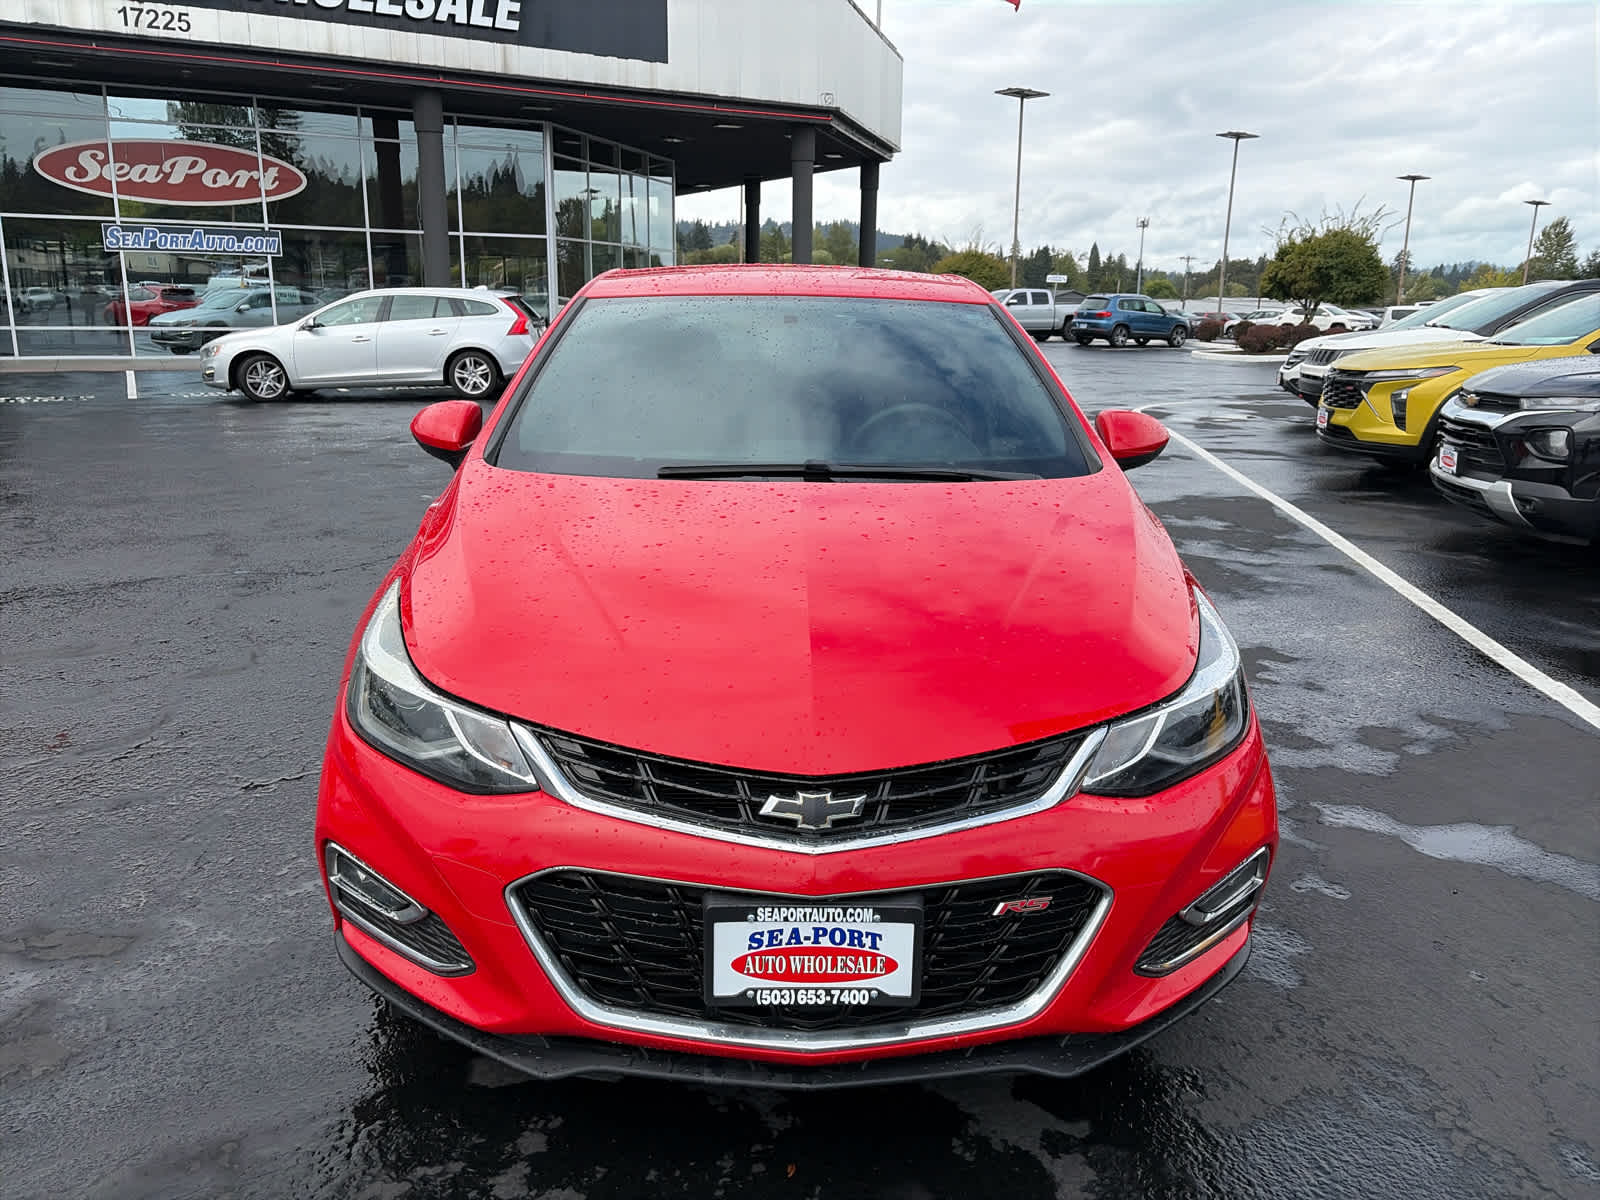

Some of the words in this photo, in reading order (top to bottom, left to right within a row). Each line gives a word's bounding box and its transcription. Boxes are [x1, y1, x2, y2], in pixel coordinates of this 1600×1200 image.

[117, 6, 191, 32] 17225
[65, 149, 280, 190] SeaPort
[757, 908, 873, 923] SEAPORTAUTO.COM
[993, 896, 1053, 916] RS
[748, 926, 883, 950] SEA-PORT
[743, 955, 787, 974] AUTO
[789, 955, 886, 975] WHOLESALE
[756, 989, 794, 1005] (503)
[798, 989, 869, 1005] 653-7400
